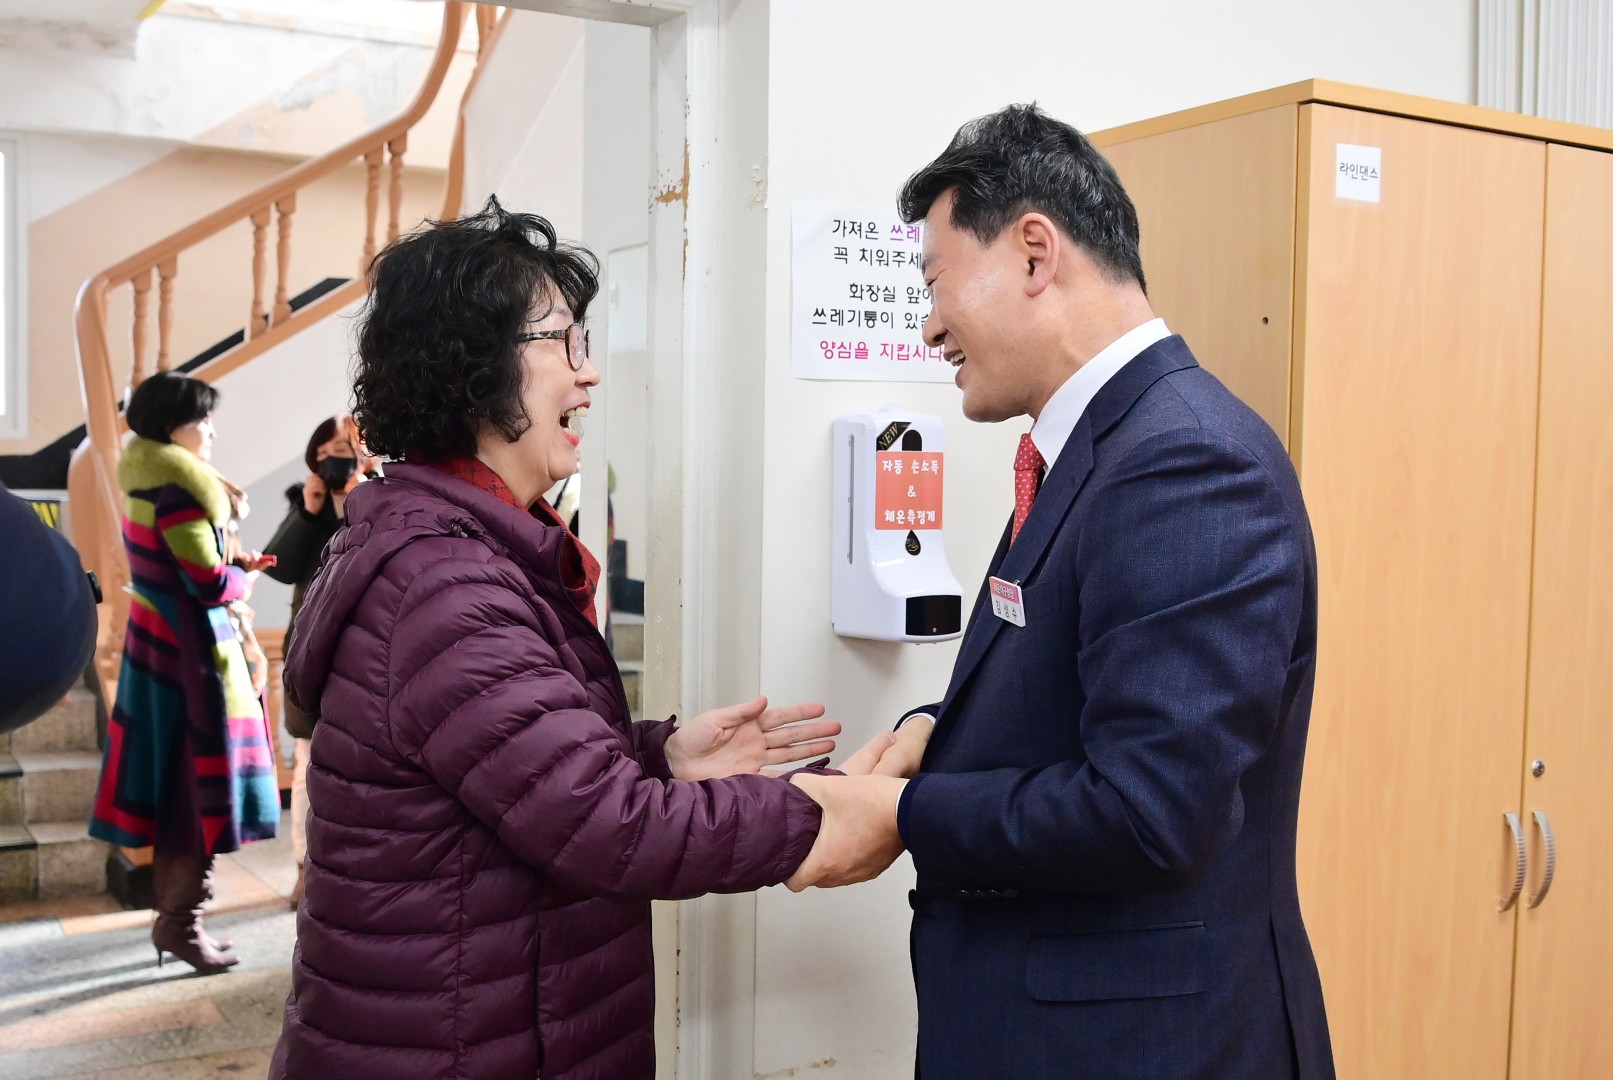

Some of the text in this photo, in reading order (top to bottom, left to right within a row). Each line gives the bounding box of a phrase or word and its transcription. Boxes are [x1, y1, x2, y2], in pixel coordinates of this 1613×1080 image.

[1339, 162, 1379, 181] 라인댄스
[832, 219, 879, 240] 가져온
[833, 246, 922, 269] 꼭 치워주세
[849, 282, 896, 303] 화장실
[812, 307, 894, 329] 쓰레기통이
[819, 340, 943, 362] 양심을 지킵시다
[878, 422, 899, 450] NEW
[882, 459, 939, 475] 자동 손소독
[907, 485, 917, 498] &
[884, 508, 936, 525] 체온측정계
